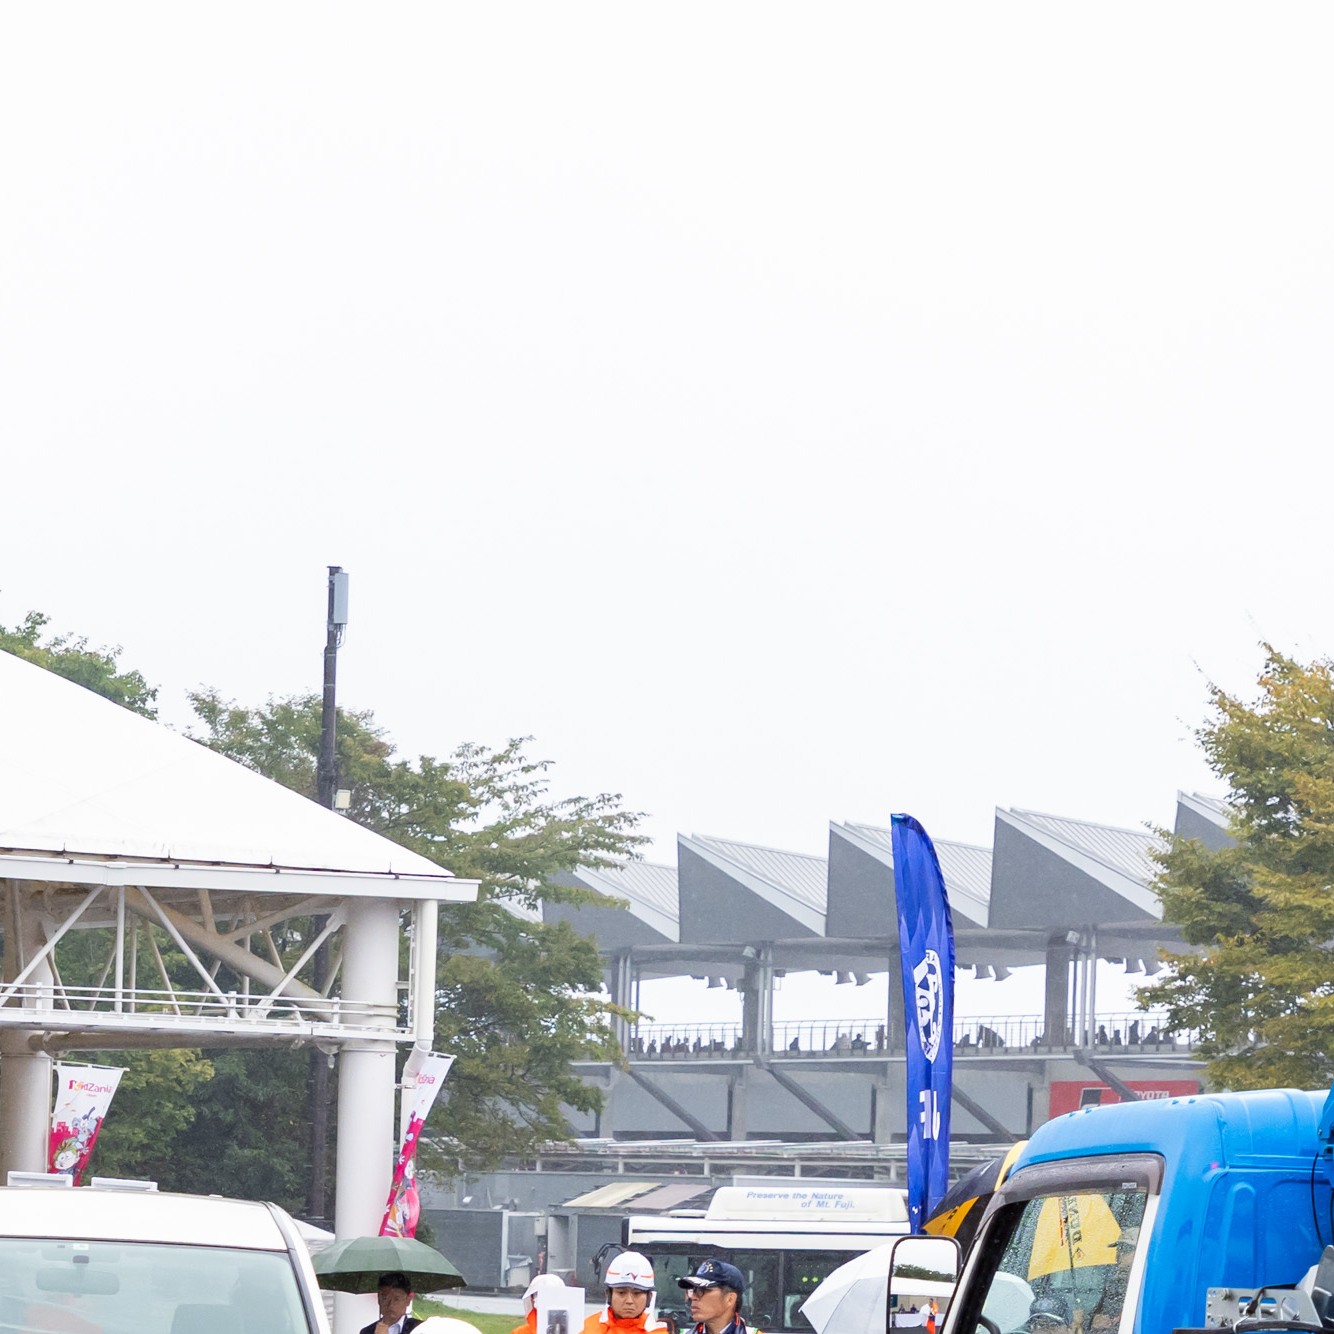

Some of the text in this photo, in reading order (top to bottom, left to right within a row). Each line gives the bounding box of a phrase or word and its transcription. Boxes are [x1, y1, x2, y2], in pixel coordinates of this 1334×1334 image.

[1134, 1091, 1169, 1100] YOTA
[746, 1191, 789, 1199] Preserve
[811, 1192, 844, 1200] Nature
[801, 1200, 855, 1210] of Mt. Fuji.
